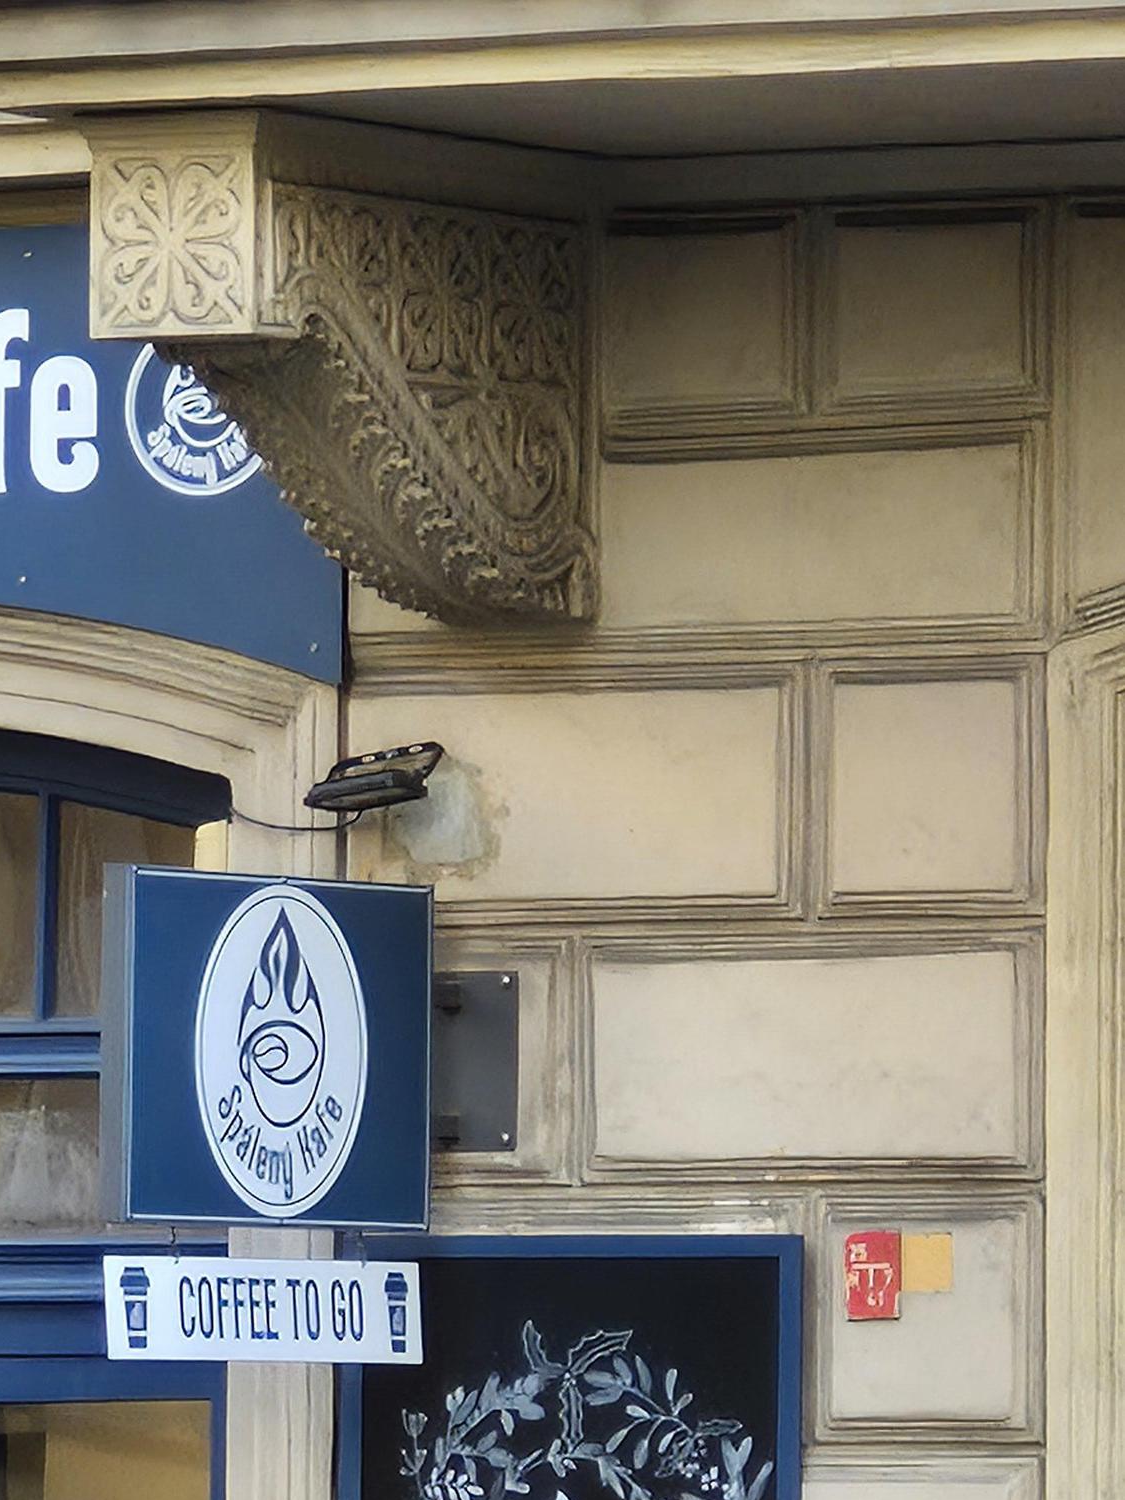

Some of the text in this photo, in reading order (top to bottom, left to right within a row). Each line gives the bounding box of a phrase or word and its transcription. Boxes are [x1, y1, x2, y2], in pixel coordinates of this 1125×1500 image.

[218, 1085, 343, 1200] Spálený Kafe
[178, 1274, 365, 1342] COFFEE TO GO
